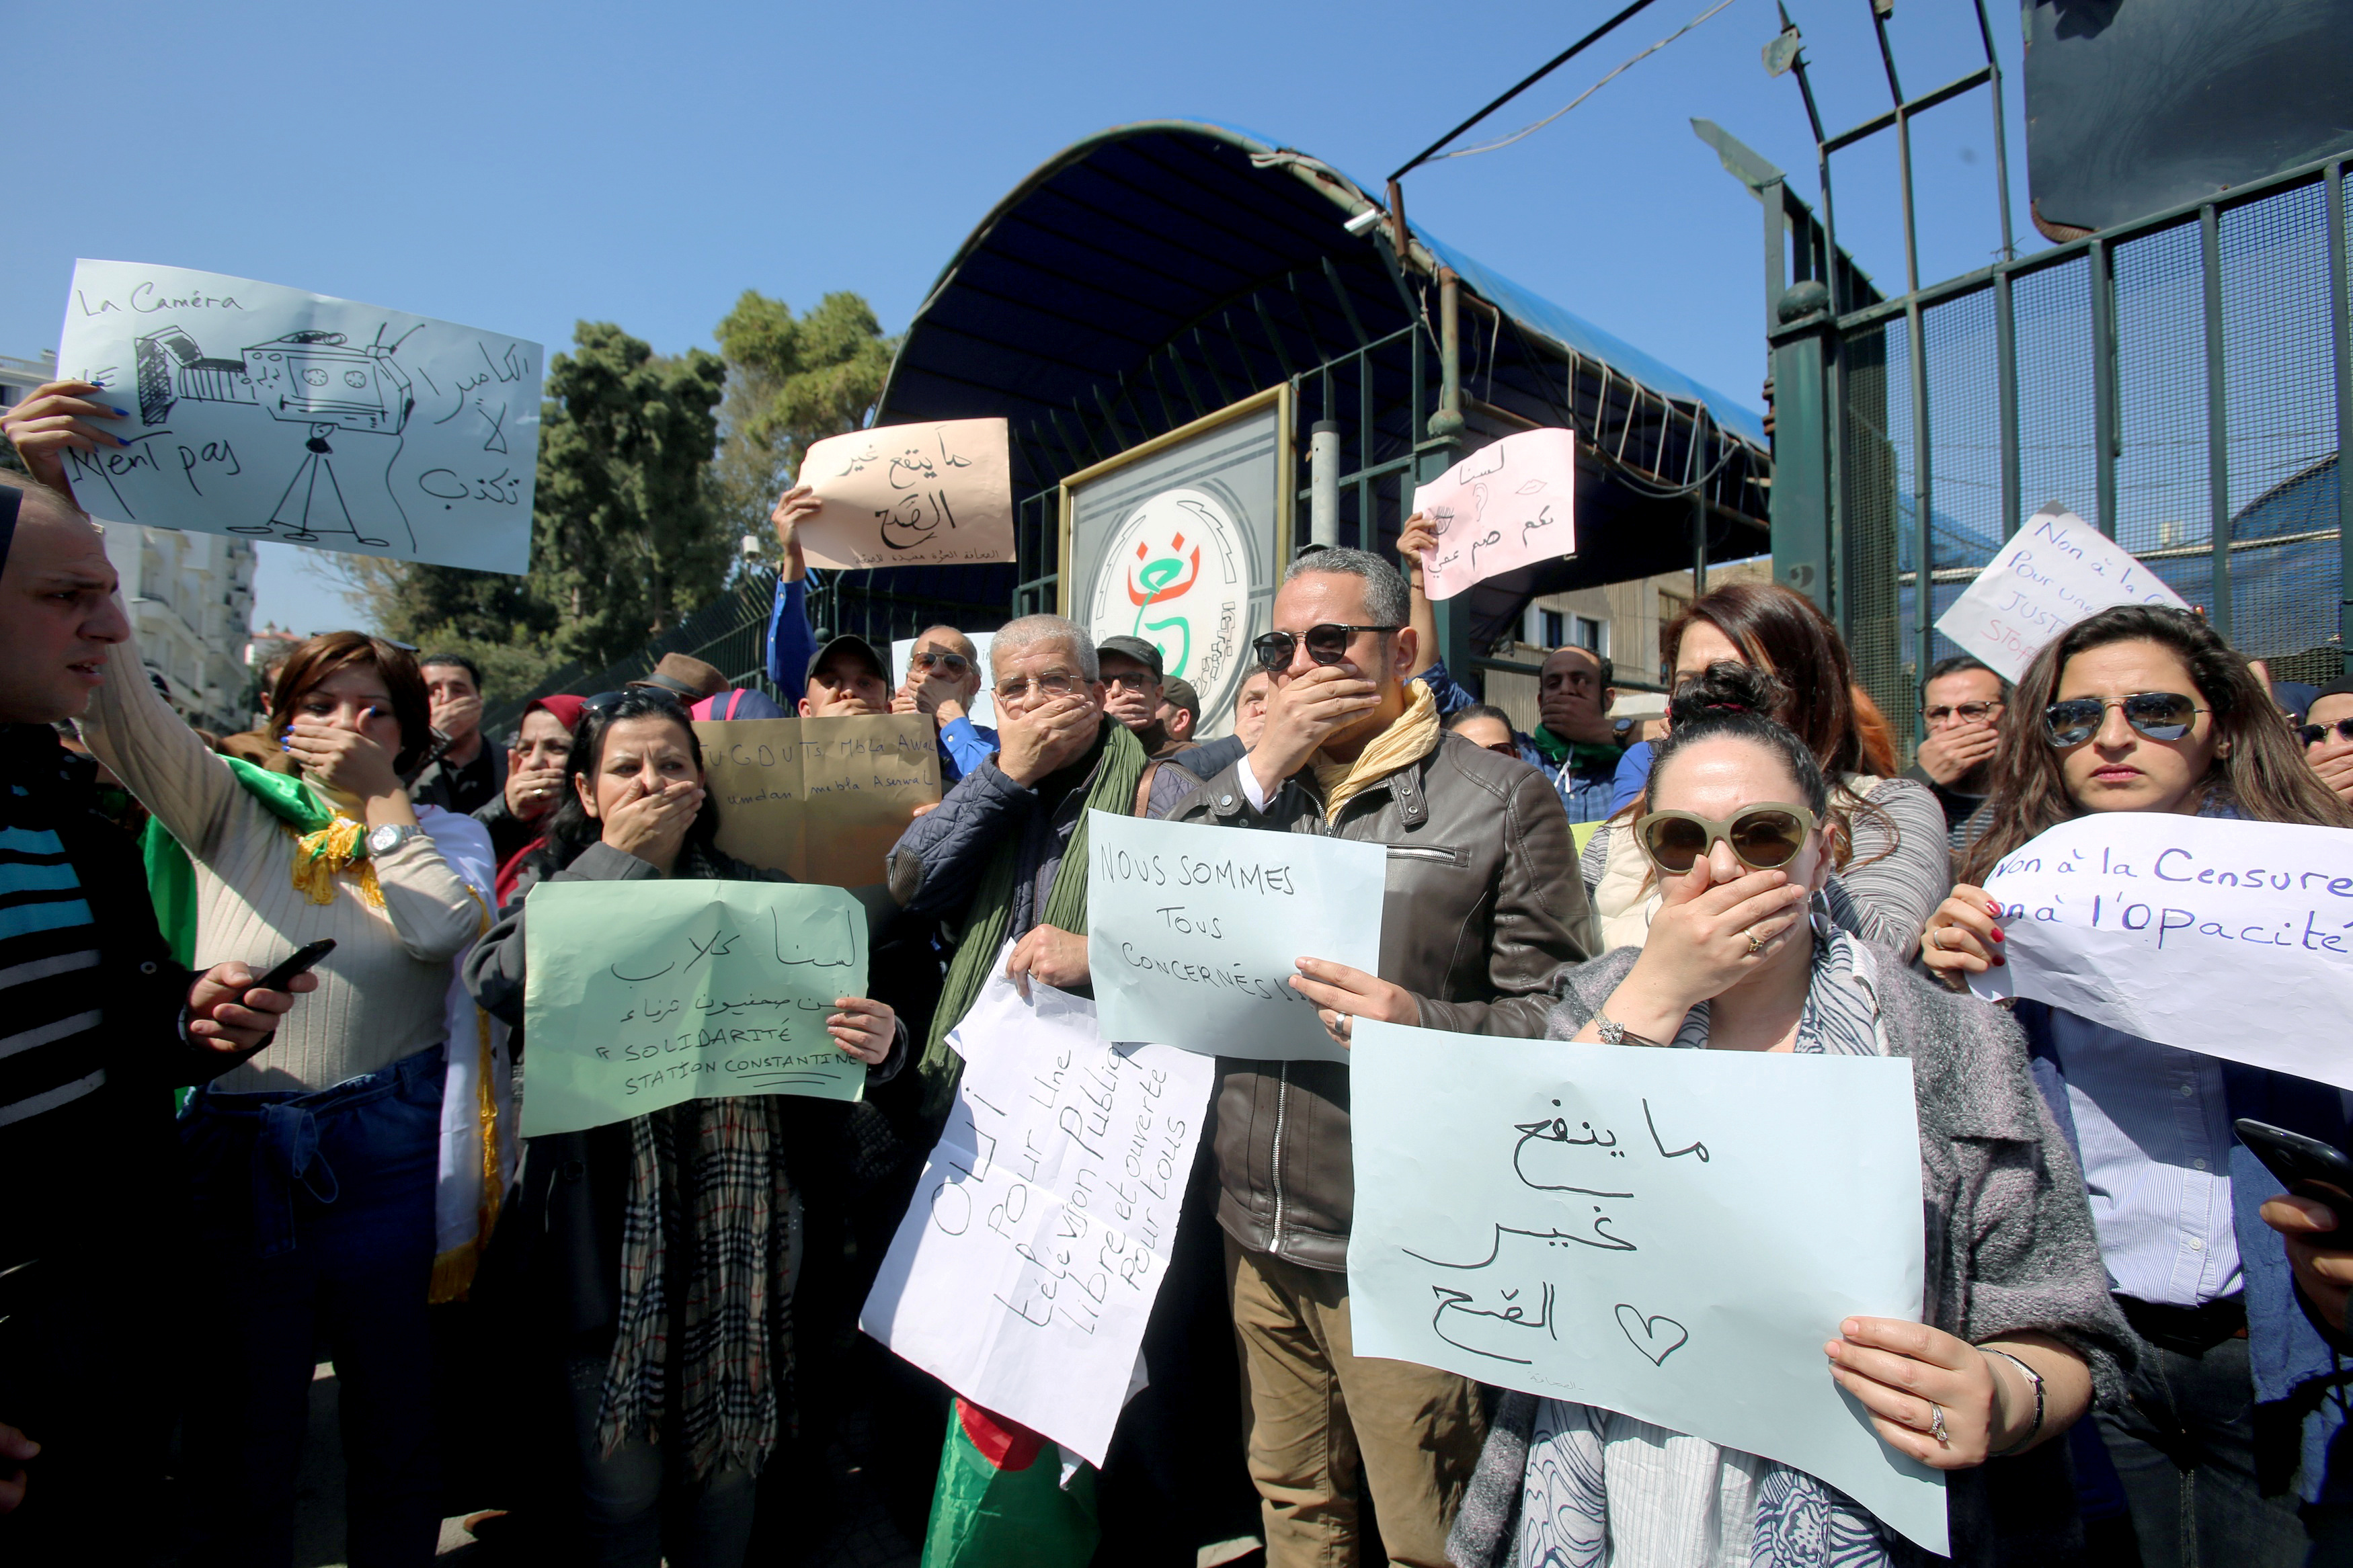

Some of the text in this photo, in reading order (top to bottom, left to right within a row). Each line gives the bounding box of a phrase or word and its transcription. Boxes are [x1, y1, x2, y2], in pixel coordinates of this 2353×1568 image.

[79, 282, 244, 317] La Caméra
[418, 341, 529, 425] الكاميرا
[477, 402, 508, 454] لا
[835, 444, 879, 477] غير
[1459, 444, 1505, 485] لسنا
[2034, 521, 2083, 561] Non
[1101, 841, 1295, 896] NOUS SOMMES
[1987, 846, 2353, 897] Non à la Censure
[610, 930, 740, 989] كلاب
[771, 905, 855, 966] لسنا
[625, 1018, 792, 1062] SOLIDARITÉ
[625, 1053, 858, 1095] STATION CONSTANTINE
[1642, 1097, 1710, 1163] ما
[1105, 1181, 1137, 1221] et
[1402, 1205, 1638, 1270] غير
